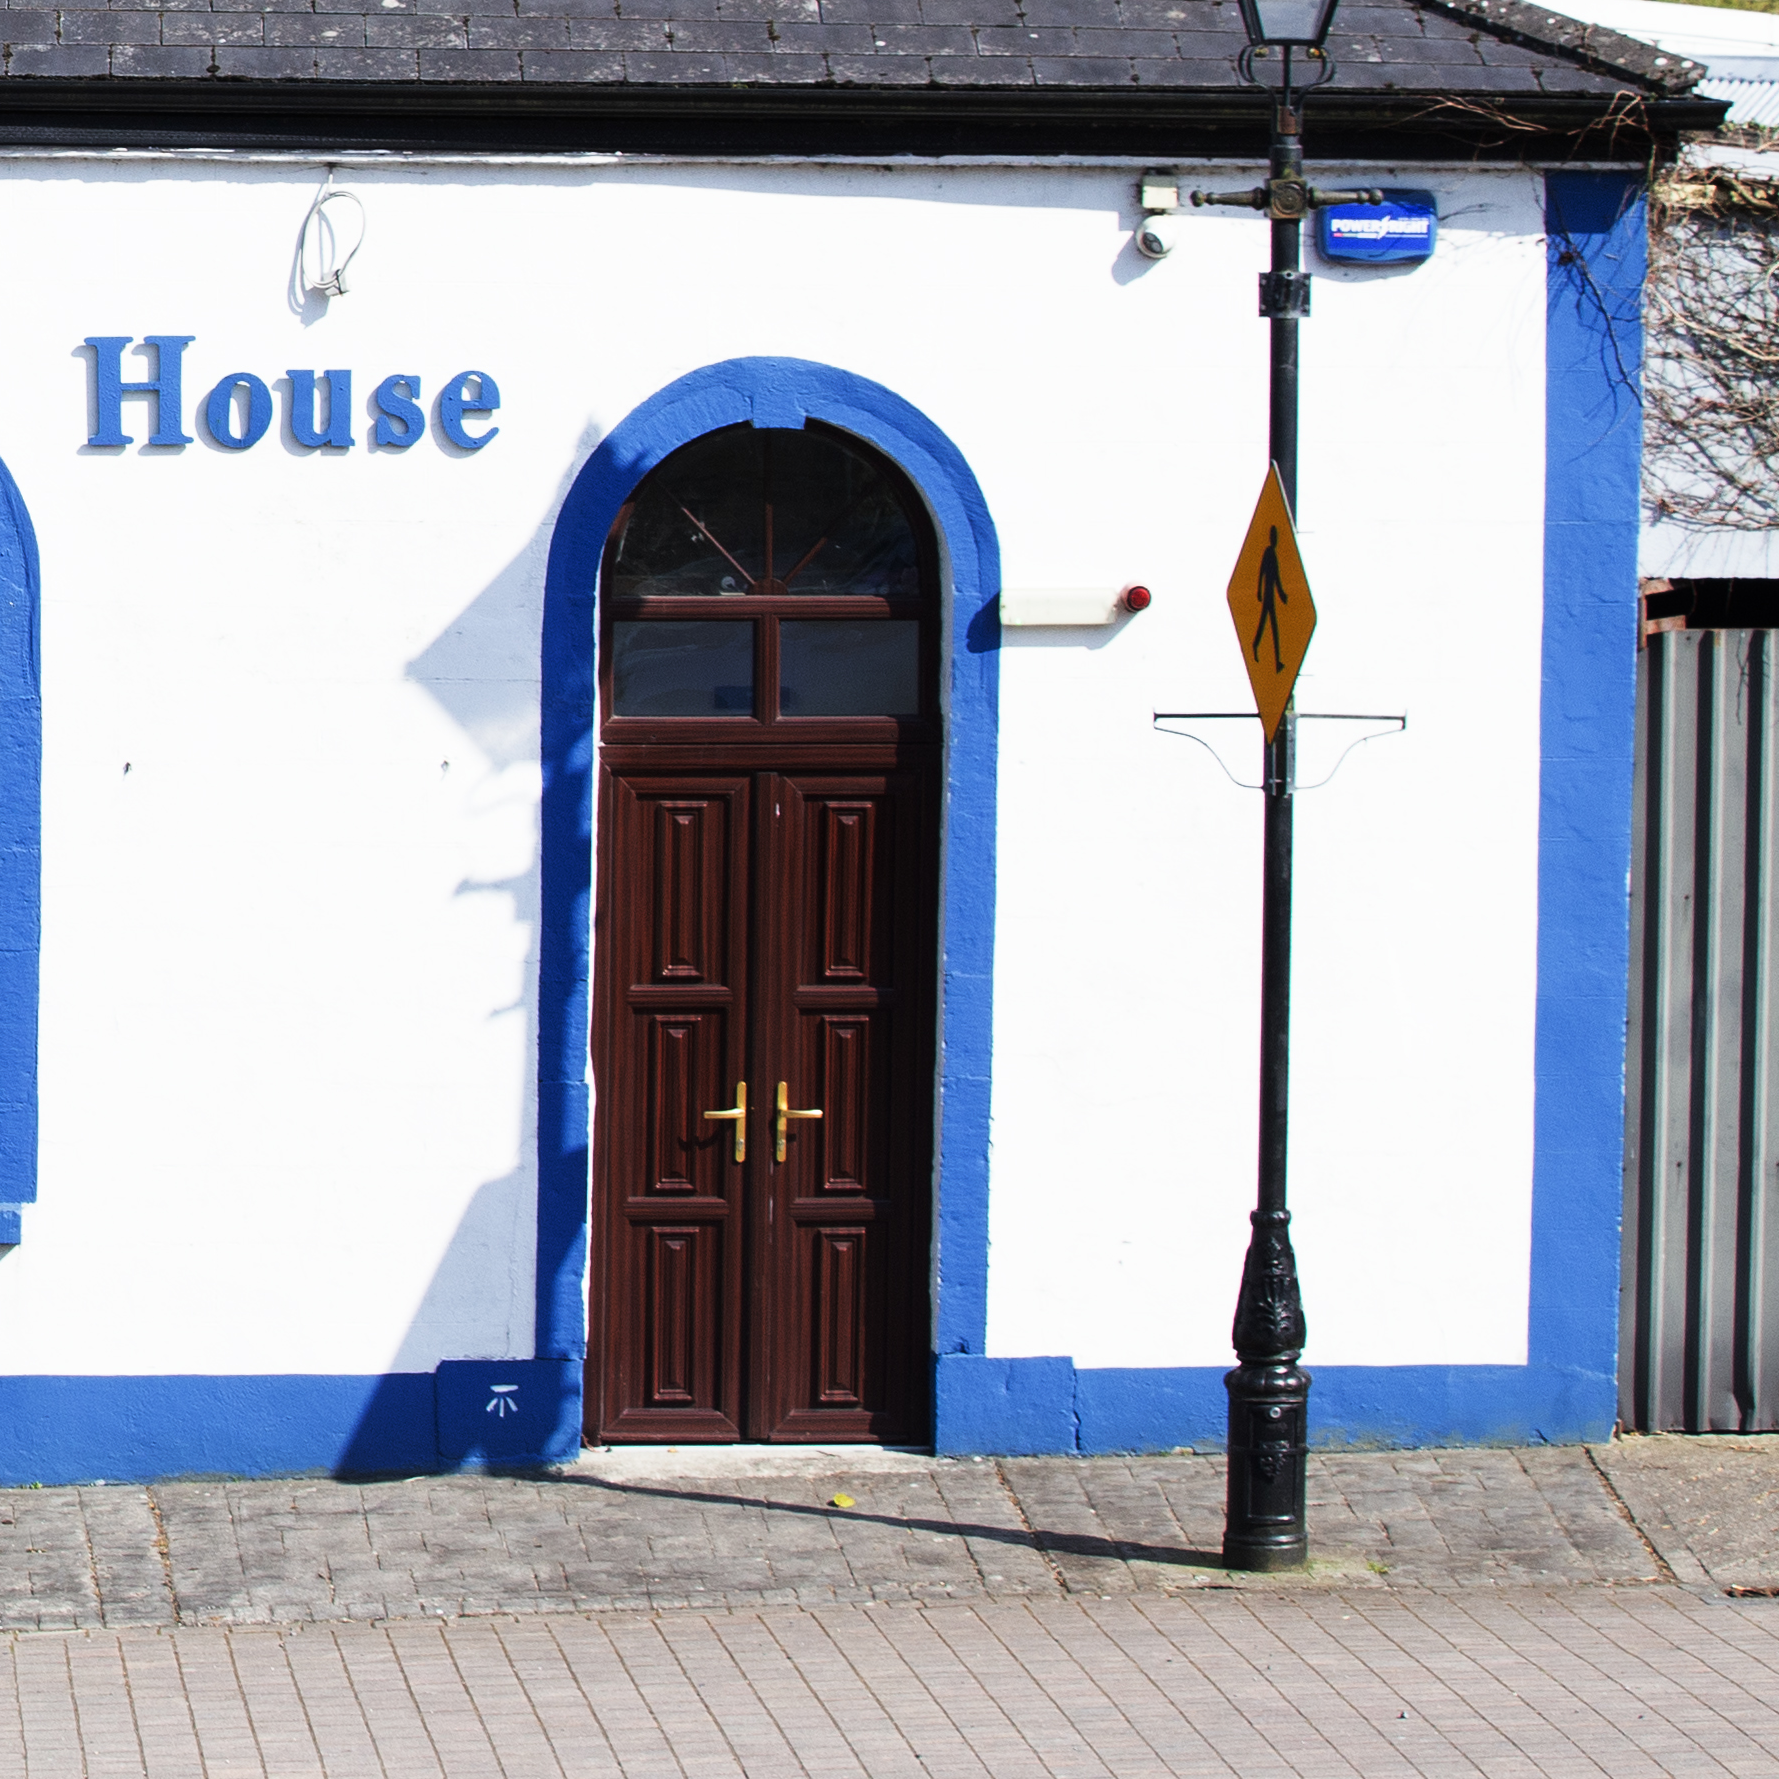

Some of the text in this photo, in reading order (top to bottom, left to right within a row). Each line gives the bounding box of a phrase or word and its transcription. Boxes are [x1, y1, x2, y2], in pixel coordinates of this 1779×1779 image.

[1331, 219, 1430, 234] POWER RIGHT
[83, 334, 501, 450] House
